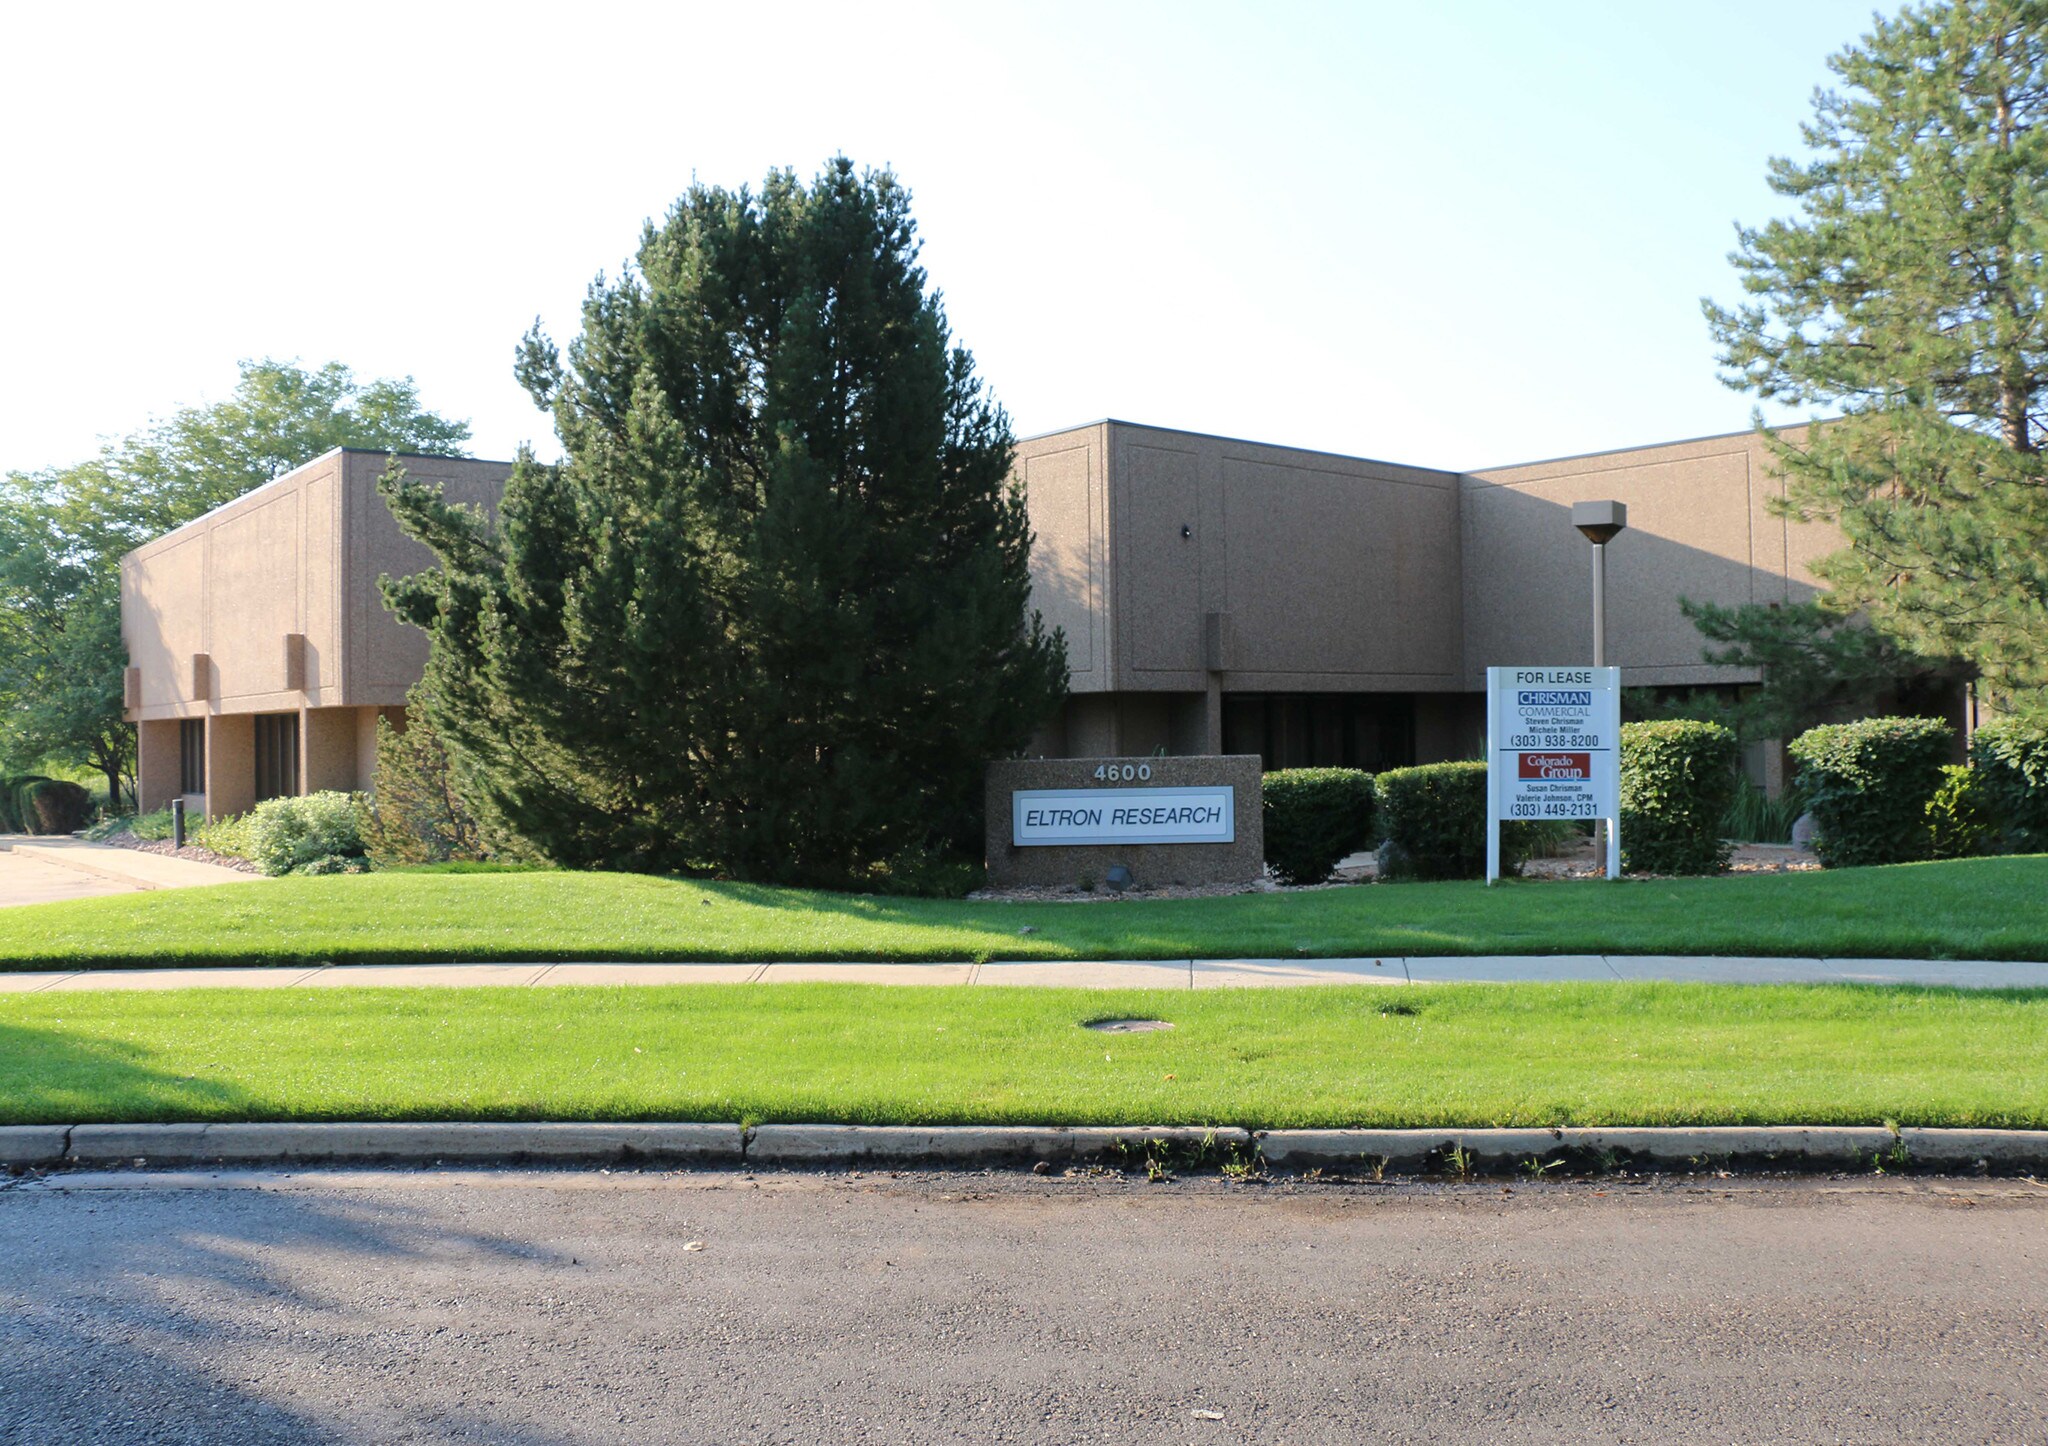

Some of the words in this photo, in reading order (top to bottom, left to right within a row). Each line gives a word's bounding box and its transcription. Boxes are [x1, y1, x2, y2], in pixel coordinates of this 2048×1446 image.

[1516, 672, 1544, 683] FOR
[1548, 672, 1592, 683] LEASE
[1519, 692, 1589, 704] CHRISMAN
[1518, 707, 1590, 717] COMMERCIAL
[1529, 726, 1558, 734] Michele
[1560, 726, 1580, 734] Miller
[1510, 735, 1540, 747] (303)
[1545, 735, 1599, 747] 938-8200
[1527, 755, 1573, 767] Colorado
[1094, 764, 1151, 782] 4600
[1540, 766, 1582, 782] Group
[1526, 784, 1548, 792] Susan
[1549, 784, 1582, 792] Chrisman
[1516, 794, 1541, 802] Valerie
[1543, 794, 1575, 803] Johnson,
[1576, 794, 1593, 802] CPM
[1510, 803, 1540, 816] (303)
[1545, 803, 1598, 816] 449-2131
[1025, 809, 1103, 827] ELTRON
[1111, 806, 1222, 825] RESEARCH
